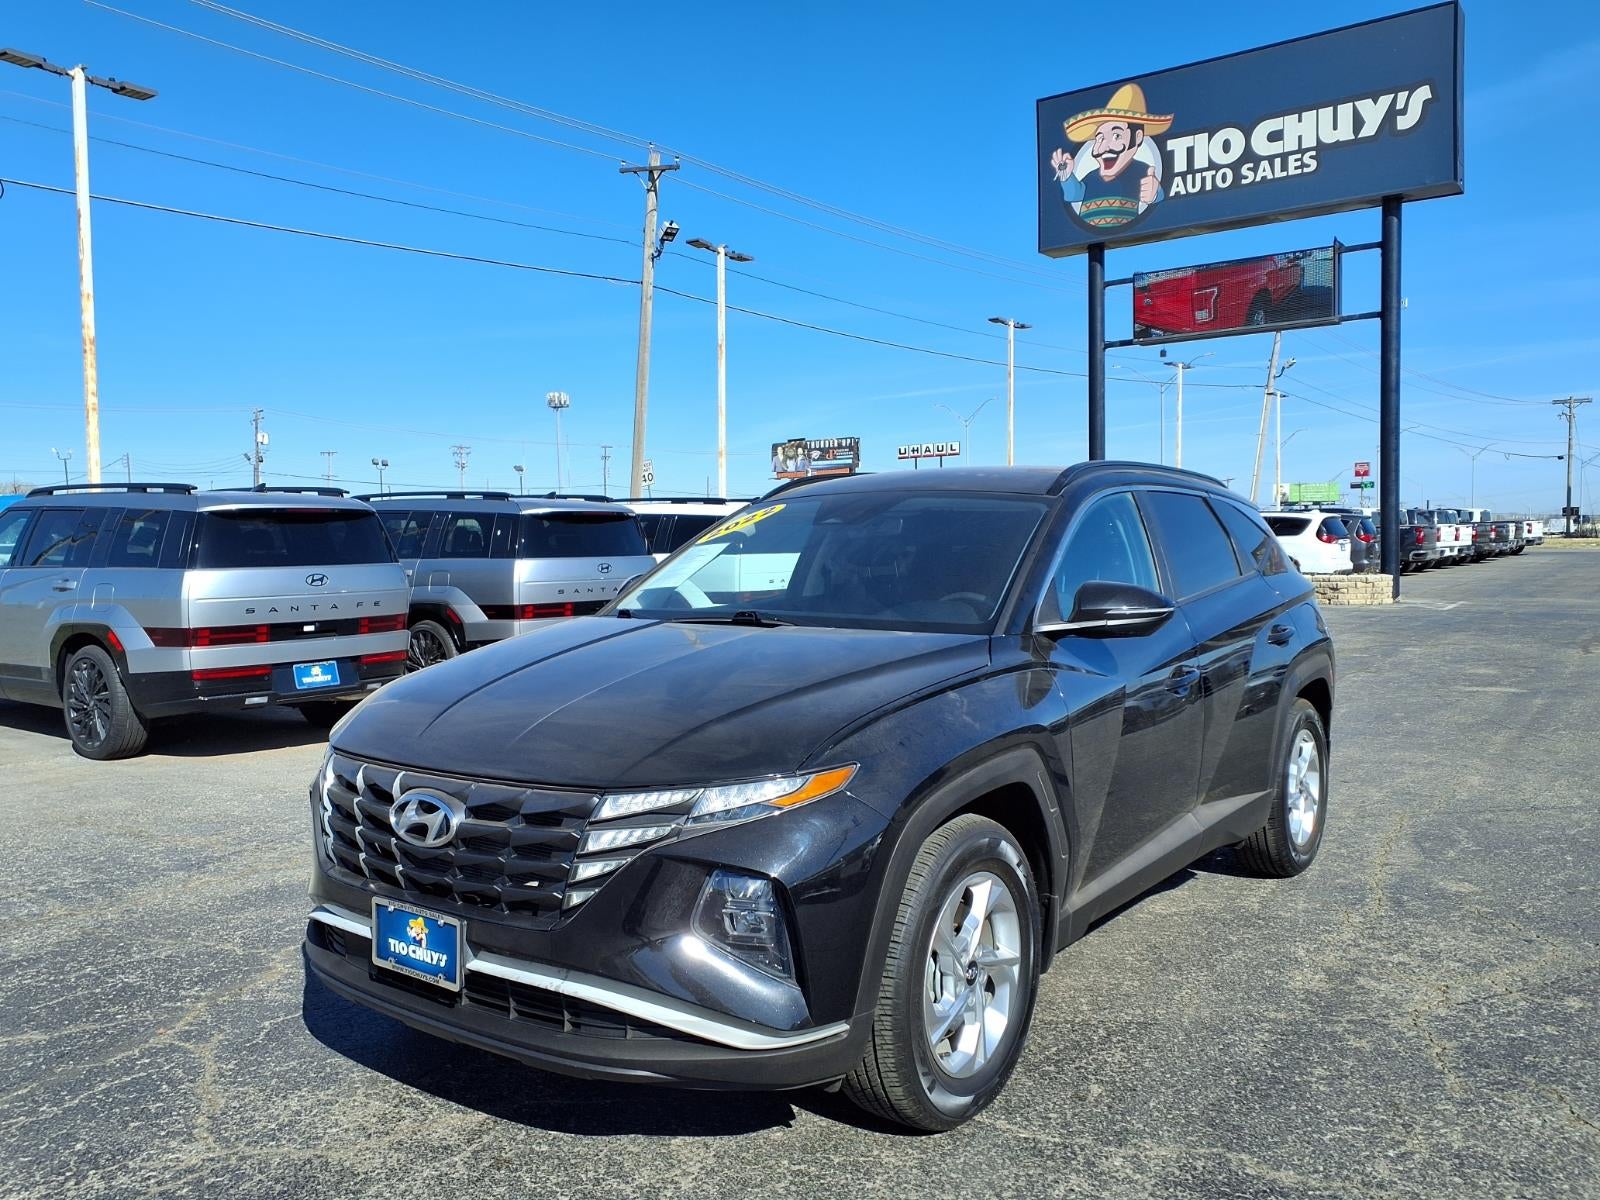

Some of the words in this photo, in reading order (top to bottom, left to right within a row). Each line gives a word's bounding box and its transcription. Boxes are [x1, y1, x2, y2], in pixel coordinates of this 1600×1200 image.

[1167, 127, 1246, 174] TIO
[1250, 85, 1433, 157] CHUY'S
[1169, 166, 1234, 197] AUTO
[1240, 151, 1319, 186] SALES
[898, 443, 957, 455] UHAUL
[705, 505, 778, 540] 2022
[557, 585, 619, 595] SANTA
[245, 603, 340, 615] SANTA
[356, 600, 382, 609] FE
[388, 937, 408, 956] TIO
[408, 944, 448, 968] CHUY'S
